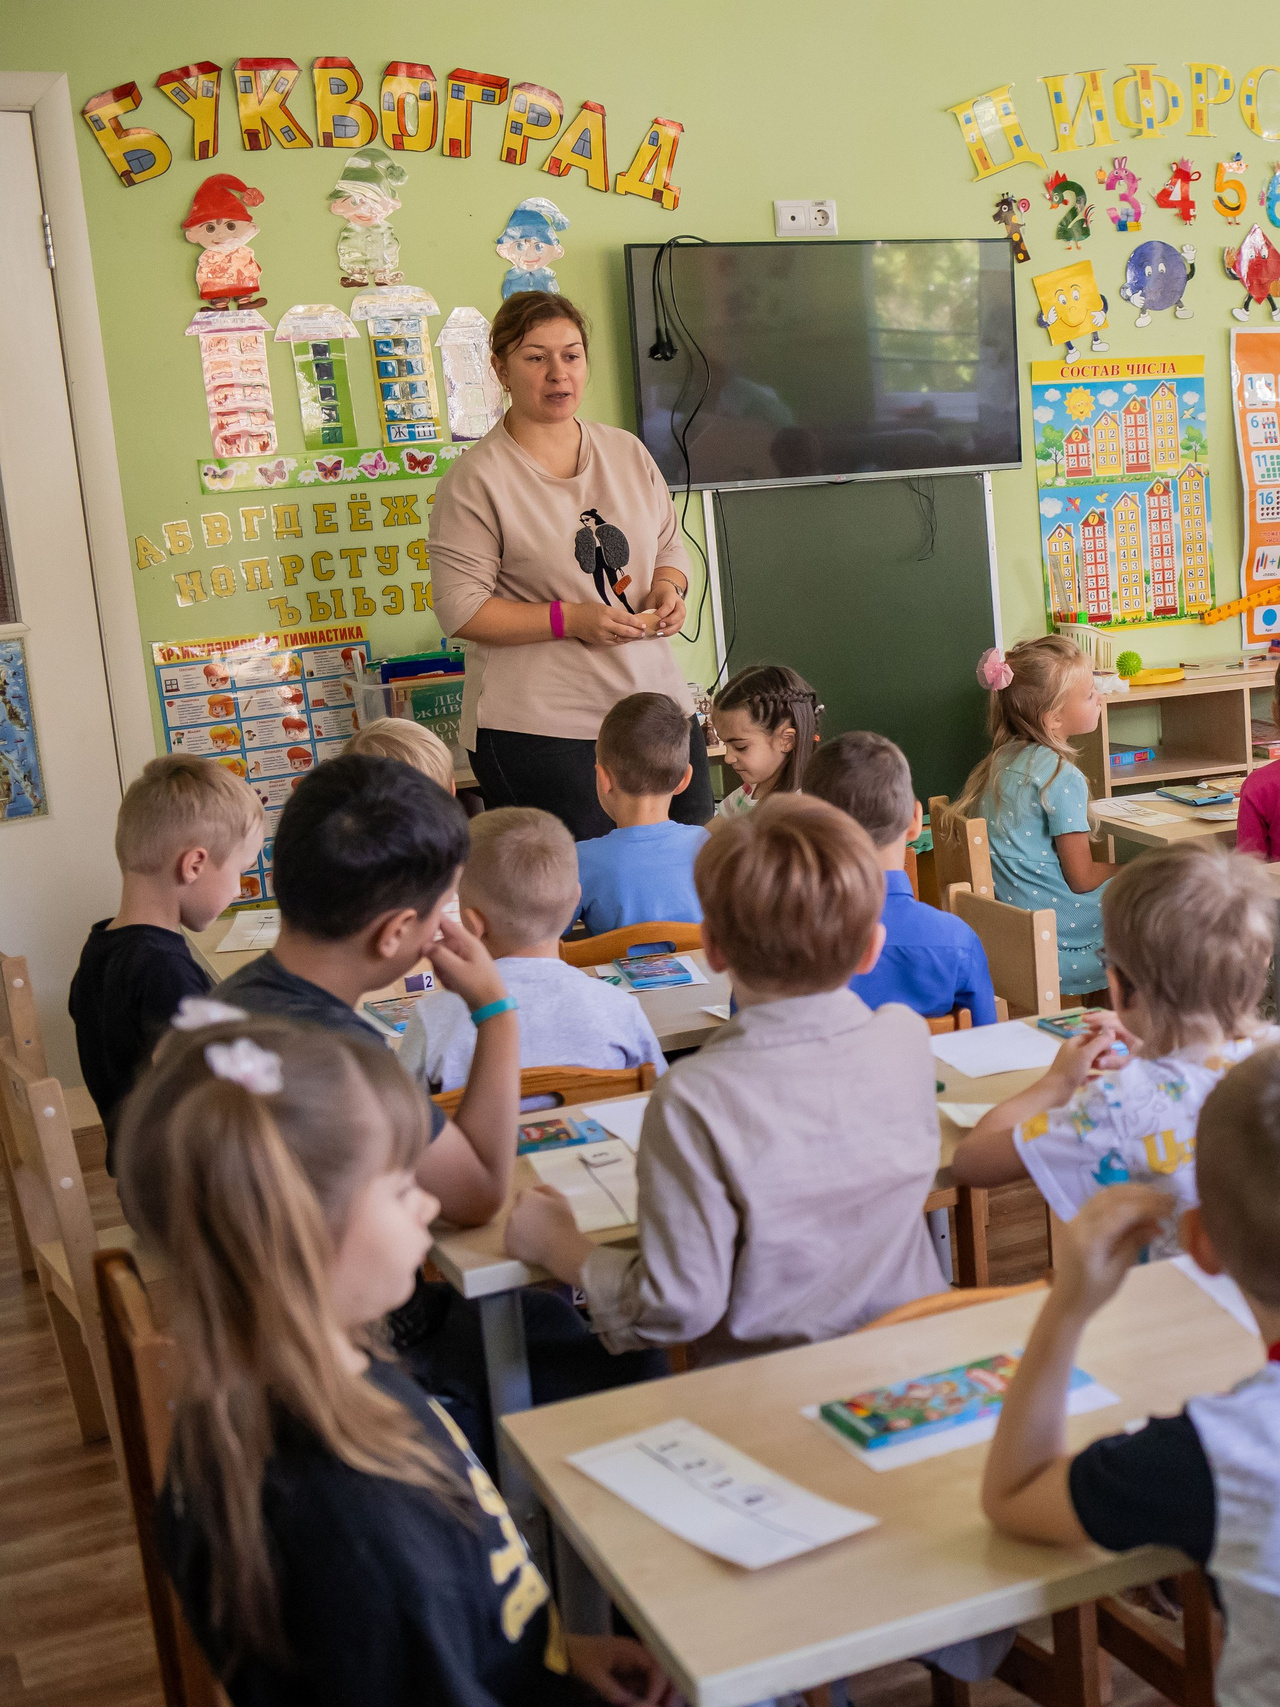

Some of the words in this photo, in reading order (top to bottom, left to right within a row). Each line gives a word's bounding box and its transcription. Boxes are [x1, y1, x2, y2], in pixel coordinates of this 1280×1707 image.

[80, 57, 685, 211] БУКВОГРАД
[1047, 174, 1094, 244] 2
[1104, 160, 1144, 232] 3
[1153, 162, 1200, 225] 4
[1213, 160, 1249, 218] 5
[1060, 365, 1120, 378] СОСТАВ
[1126, 362, 1177, 375] ЧИСЛА
[1248, 377, 1254, 390] 1
[1160, 388, 1167, 396] 5
[1132, 403, 1138, 411] 4
[1156, 401, 1162, 409] 1
[1166, 401, 1173, 409] 4
[1103, 417, 1109, 425] 3
[1128, 416, 1133, 424] 1
[1138, 415, 1145, 423] 3
[1157, 414, 1163, 422] 2
[1167, 414, 1173, 422] 3
[1251, 415, 1259, 428] 6
[392, 425, 407, 440] Ж
[416, 424, 434, 438] Ш
[1074, 431, 1080, 440] 2
[1099, 431, 1104, 439] 1
[1109, 430, 1116, 438] 2
[1129, 428, 1135, 436] 2
[1139, 428, 1145, 436] 2
[1158, 426, 1164, 435] 3
[1167, 426, 1174, 434] 2
[1099, 443, 1105, 452] 2
[1111, 443, 1116, 451] 1
[1129, 442, 1135, 450] 3
[1140, 440, 1145, 448] 1
[1158, 440, 1165, 448] 4
[1169, 439, 1174, 447] 1
[1070, 445, 1075, 454] 1
[1081, 444, 1086, 452] 1
[1100, 456, 1106, 465] 3
[1110, 455, 1117, 463] 0
[1129, 454, 1136, 463] 4
[1140, 453, 1146, 461] 0
[1159, 452, 1166, 460] 5
[1169, 452, 1175, 460] 0
[1255, 454, 1268, 467] 11
[1070, 458, 1076, 467] 2
[1081, 457, 1087, 465] 0
[1187, 468, 1195, 478] 10
[1156, 484, 1162, 493] 9
[1123, 499, 1129, 507] 8
[1258, 492, 1274, 505] 16
[1091, 514, 1096, 524] 7
[1057, 530, 1063, 539] 6
[283, 626, 364, 648] ГИМНАСТИКА
[425, 976, 433, 988] 2
